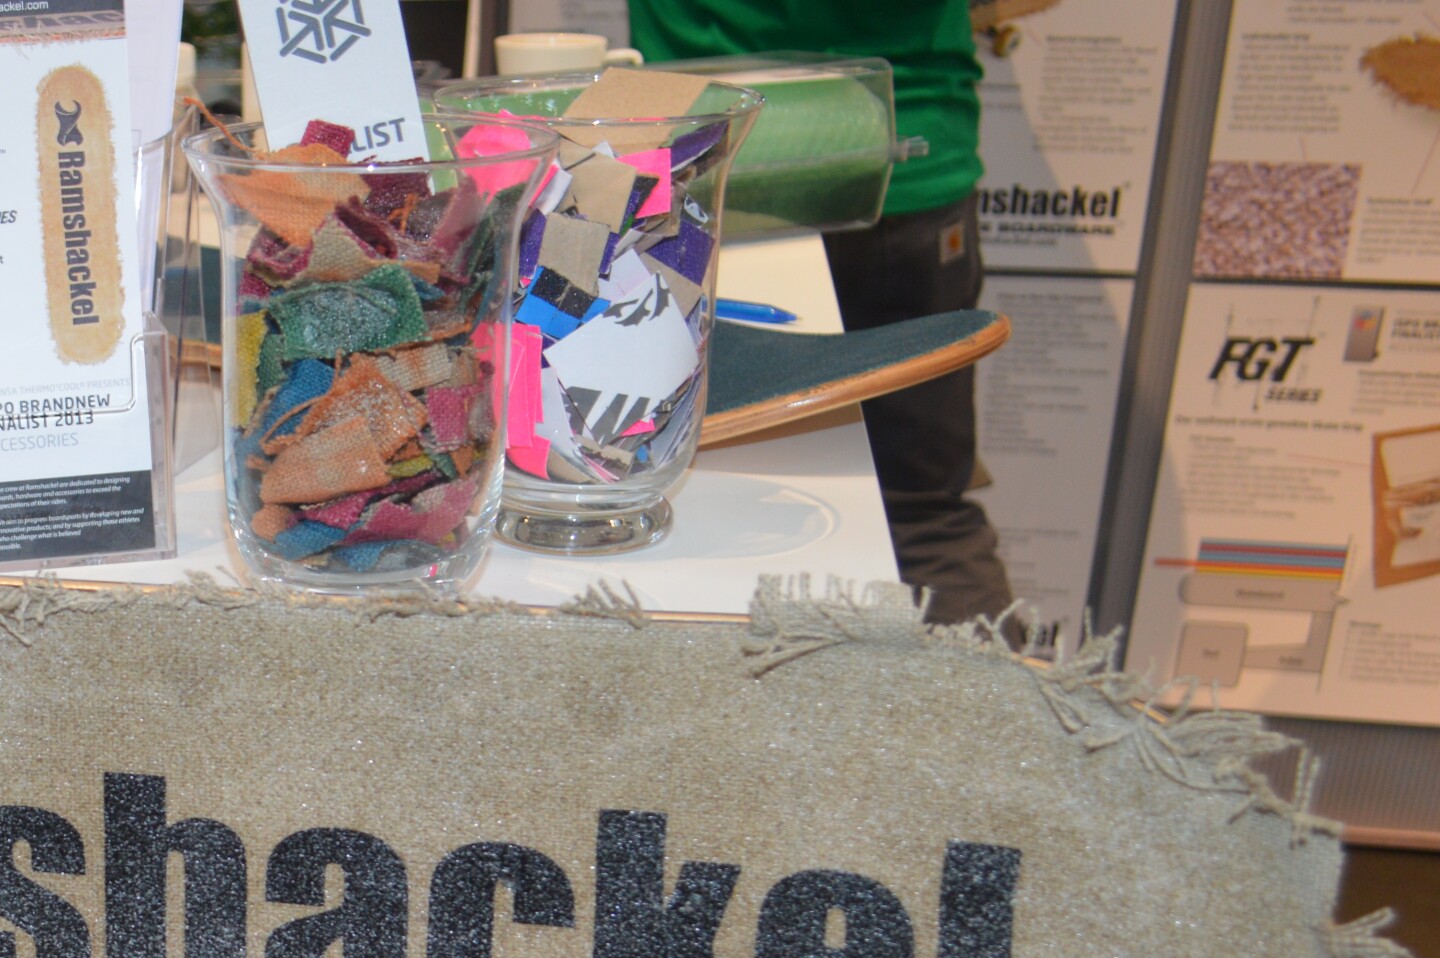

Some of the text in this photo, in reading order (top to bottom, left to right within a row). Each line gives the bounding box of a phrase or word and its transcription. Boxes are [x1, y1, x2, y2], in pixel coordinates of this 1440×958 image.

[348, 117, 406, 153] LIST
[58, 151, 100, 325] Ramshackel
[1207, 336, 1316, 382] FGT
[20, 393, 111, 414] BRANDNEW
[55, 409, 94, 427] 2013
[25, 482, 59, 490] Ramshackel
[69, 478, 97, 487] dedicated
[104, 476, 131, 484] designing
[16, 492, 42, 500] hardware
[55, 488, 85, 497] accessories
[24, 516, 48, 525] progress
[82, 512, 89, 520] by
[72, 519, 103, 528] supporting
[10, 533, 38, 541] challenge
[58, 529, 82, 537] believed
